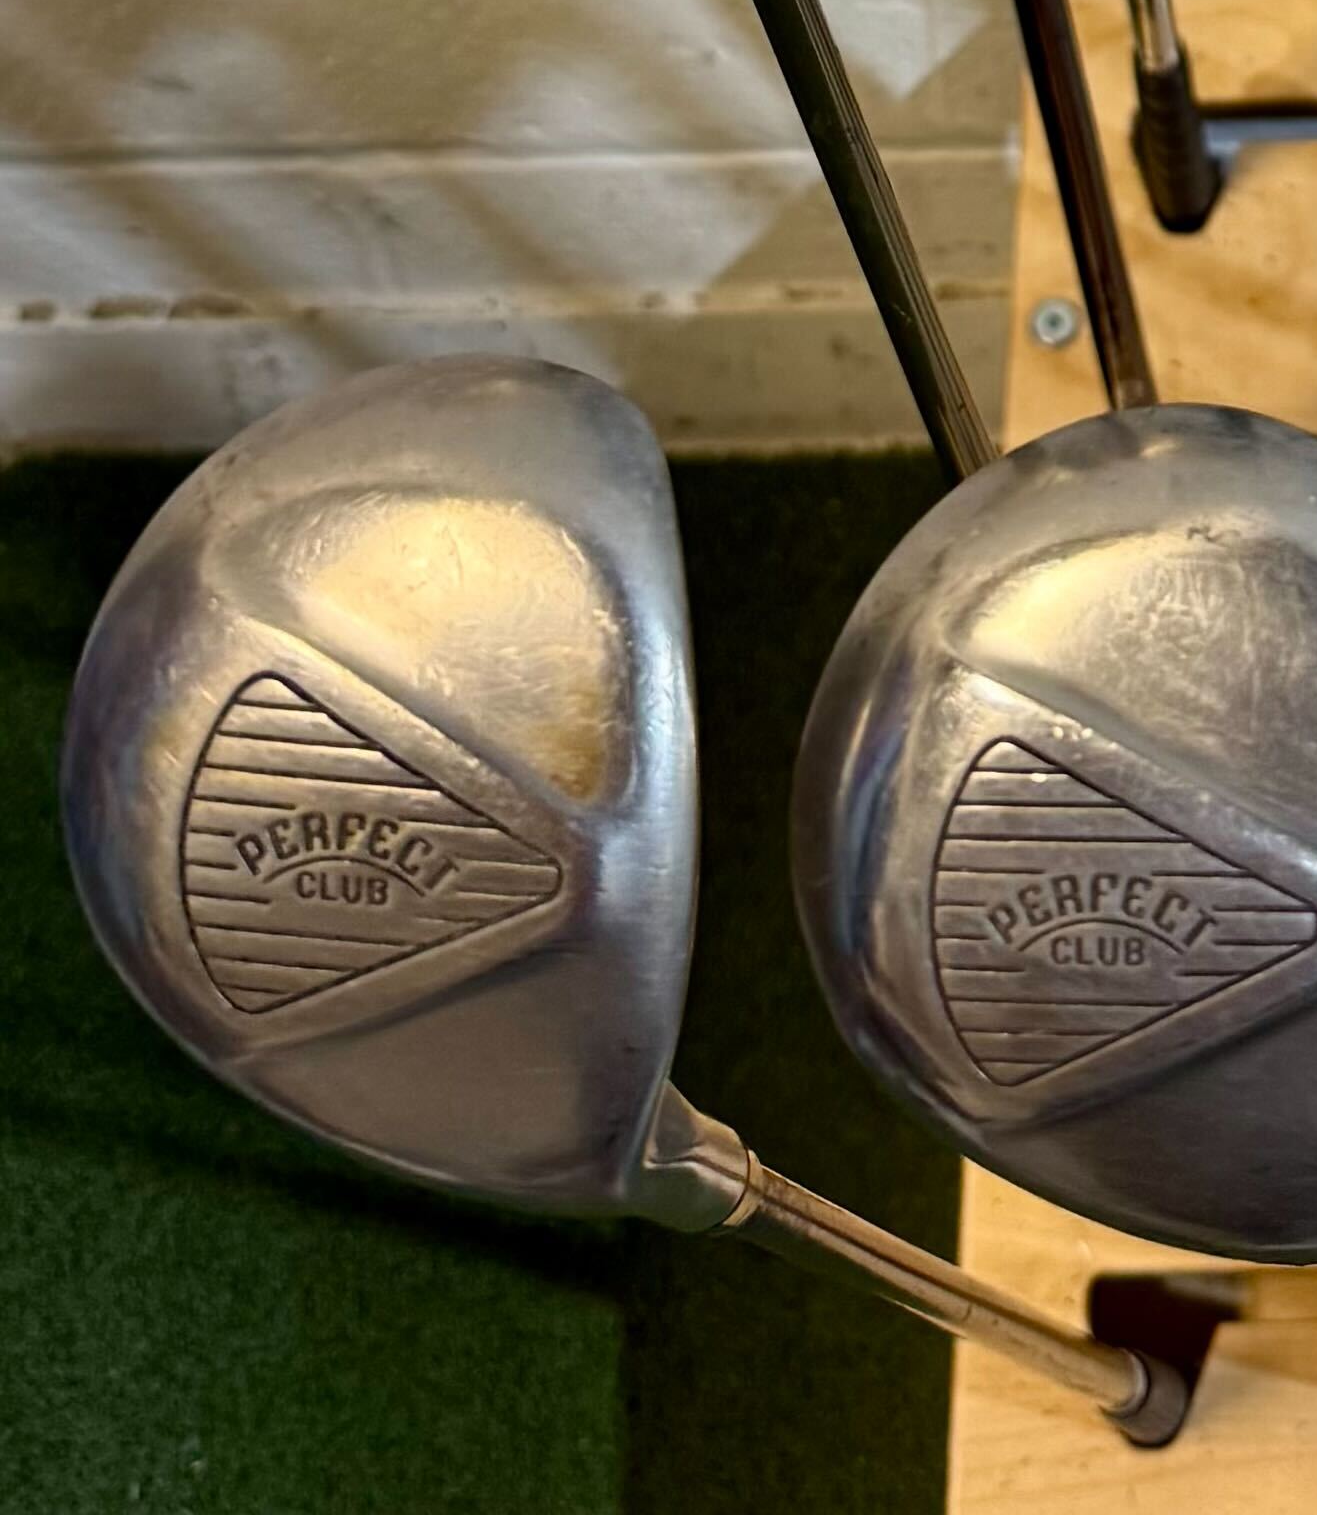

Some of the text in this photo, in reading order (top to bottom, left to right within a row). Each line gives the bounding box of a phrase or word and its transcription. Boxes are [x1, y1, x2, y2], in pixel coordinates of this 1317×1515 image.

[234, 810, 461, 897] PERFECT
[295, 868, 390, 907] CLUB
[987, 872, 1220, 947] PERFECT
[1051, 935, 1146, 967] CLUB
